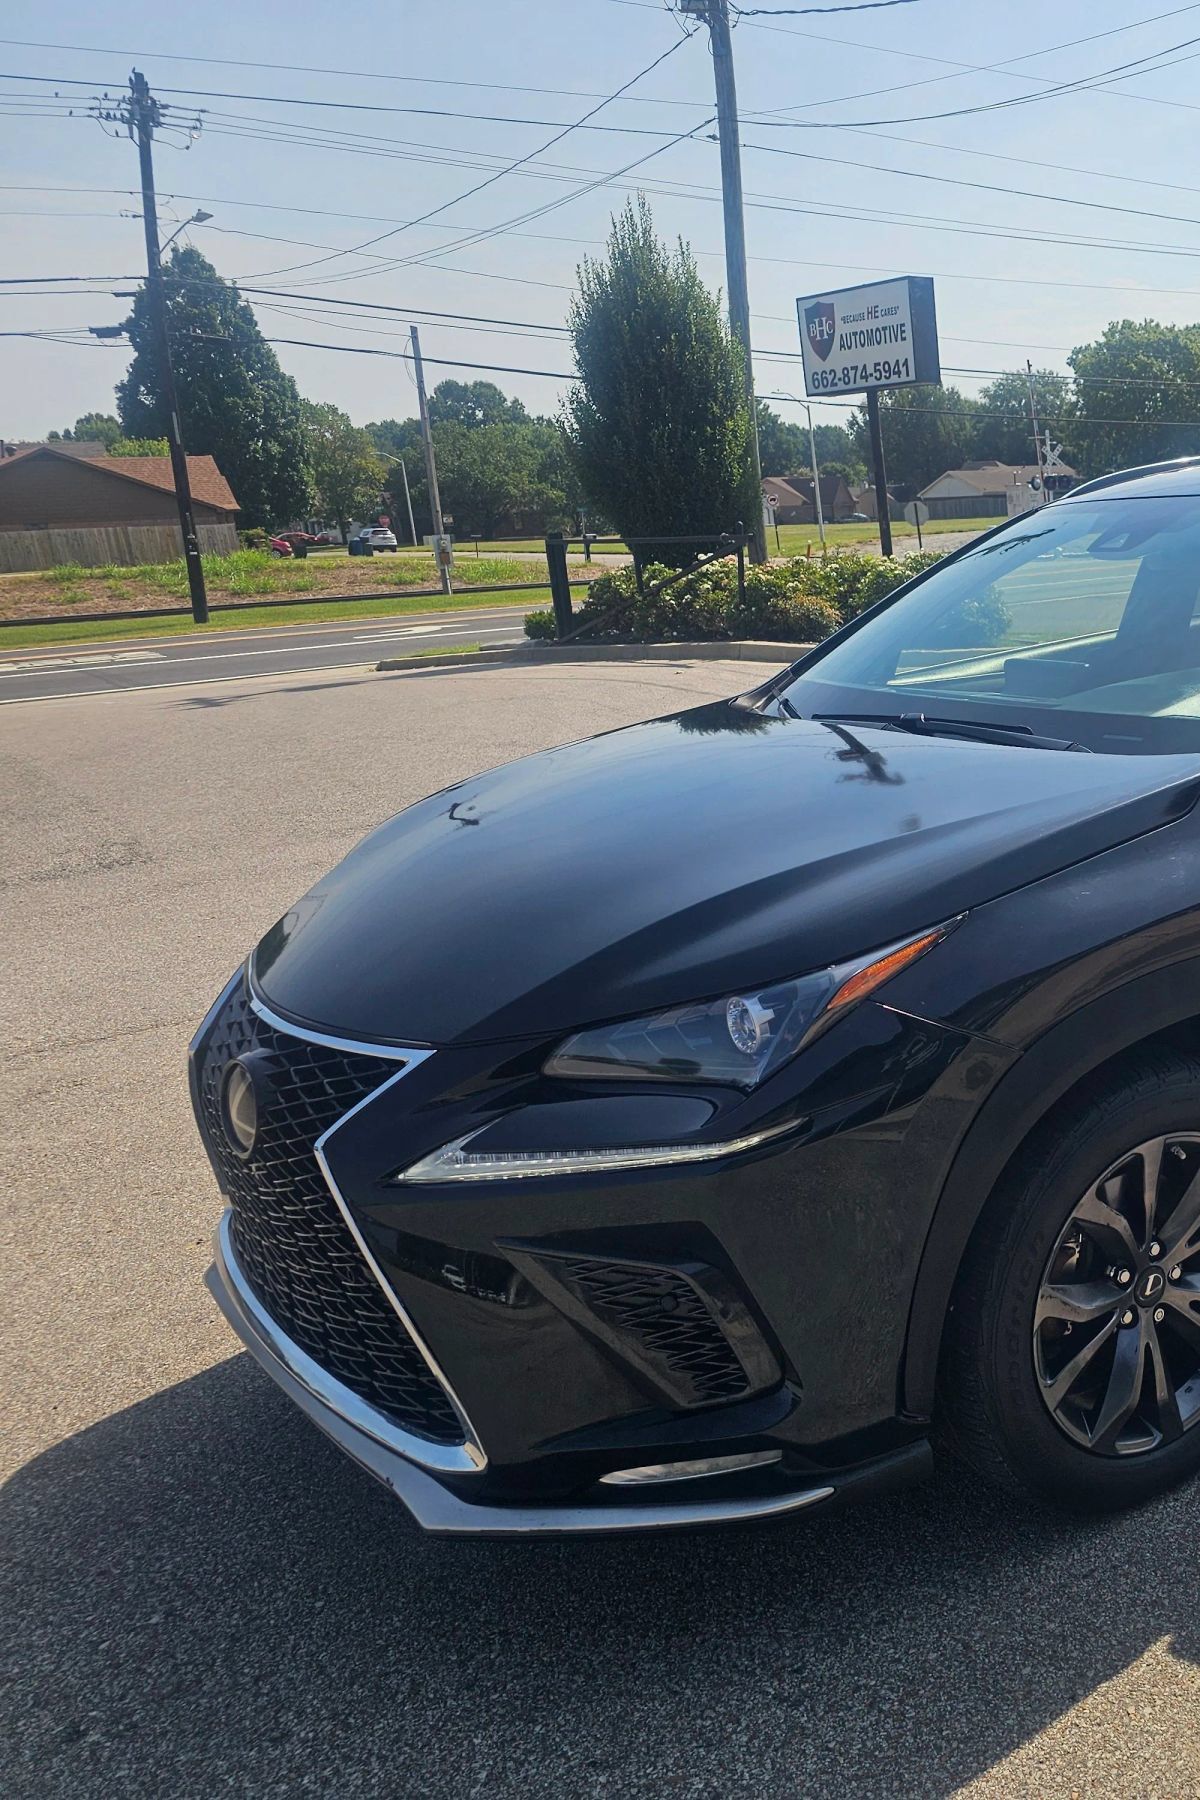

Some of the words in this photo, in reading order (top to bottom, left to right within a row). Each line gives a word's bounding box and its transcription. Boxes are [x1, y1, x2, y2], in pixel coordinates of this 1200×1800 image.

[866, 305, 879, 320] HE
[809, 316, 834, 341] BHC
[840, 323, 906, 351] AUTOMOTIVE
[812, 358, 910, 389] 662-874-5941
